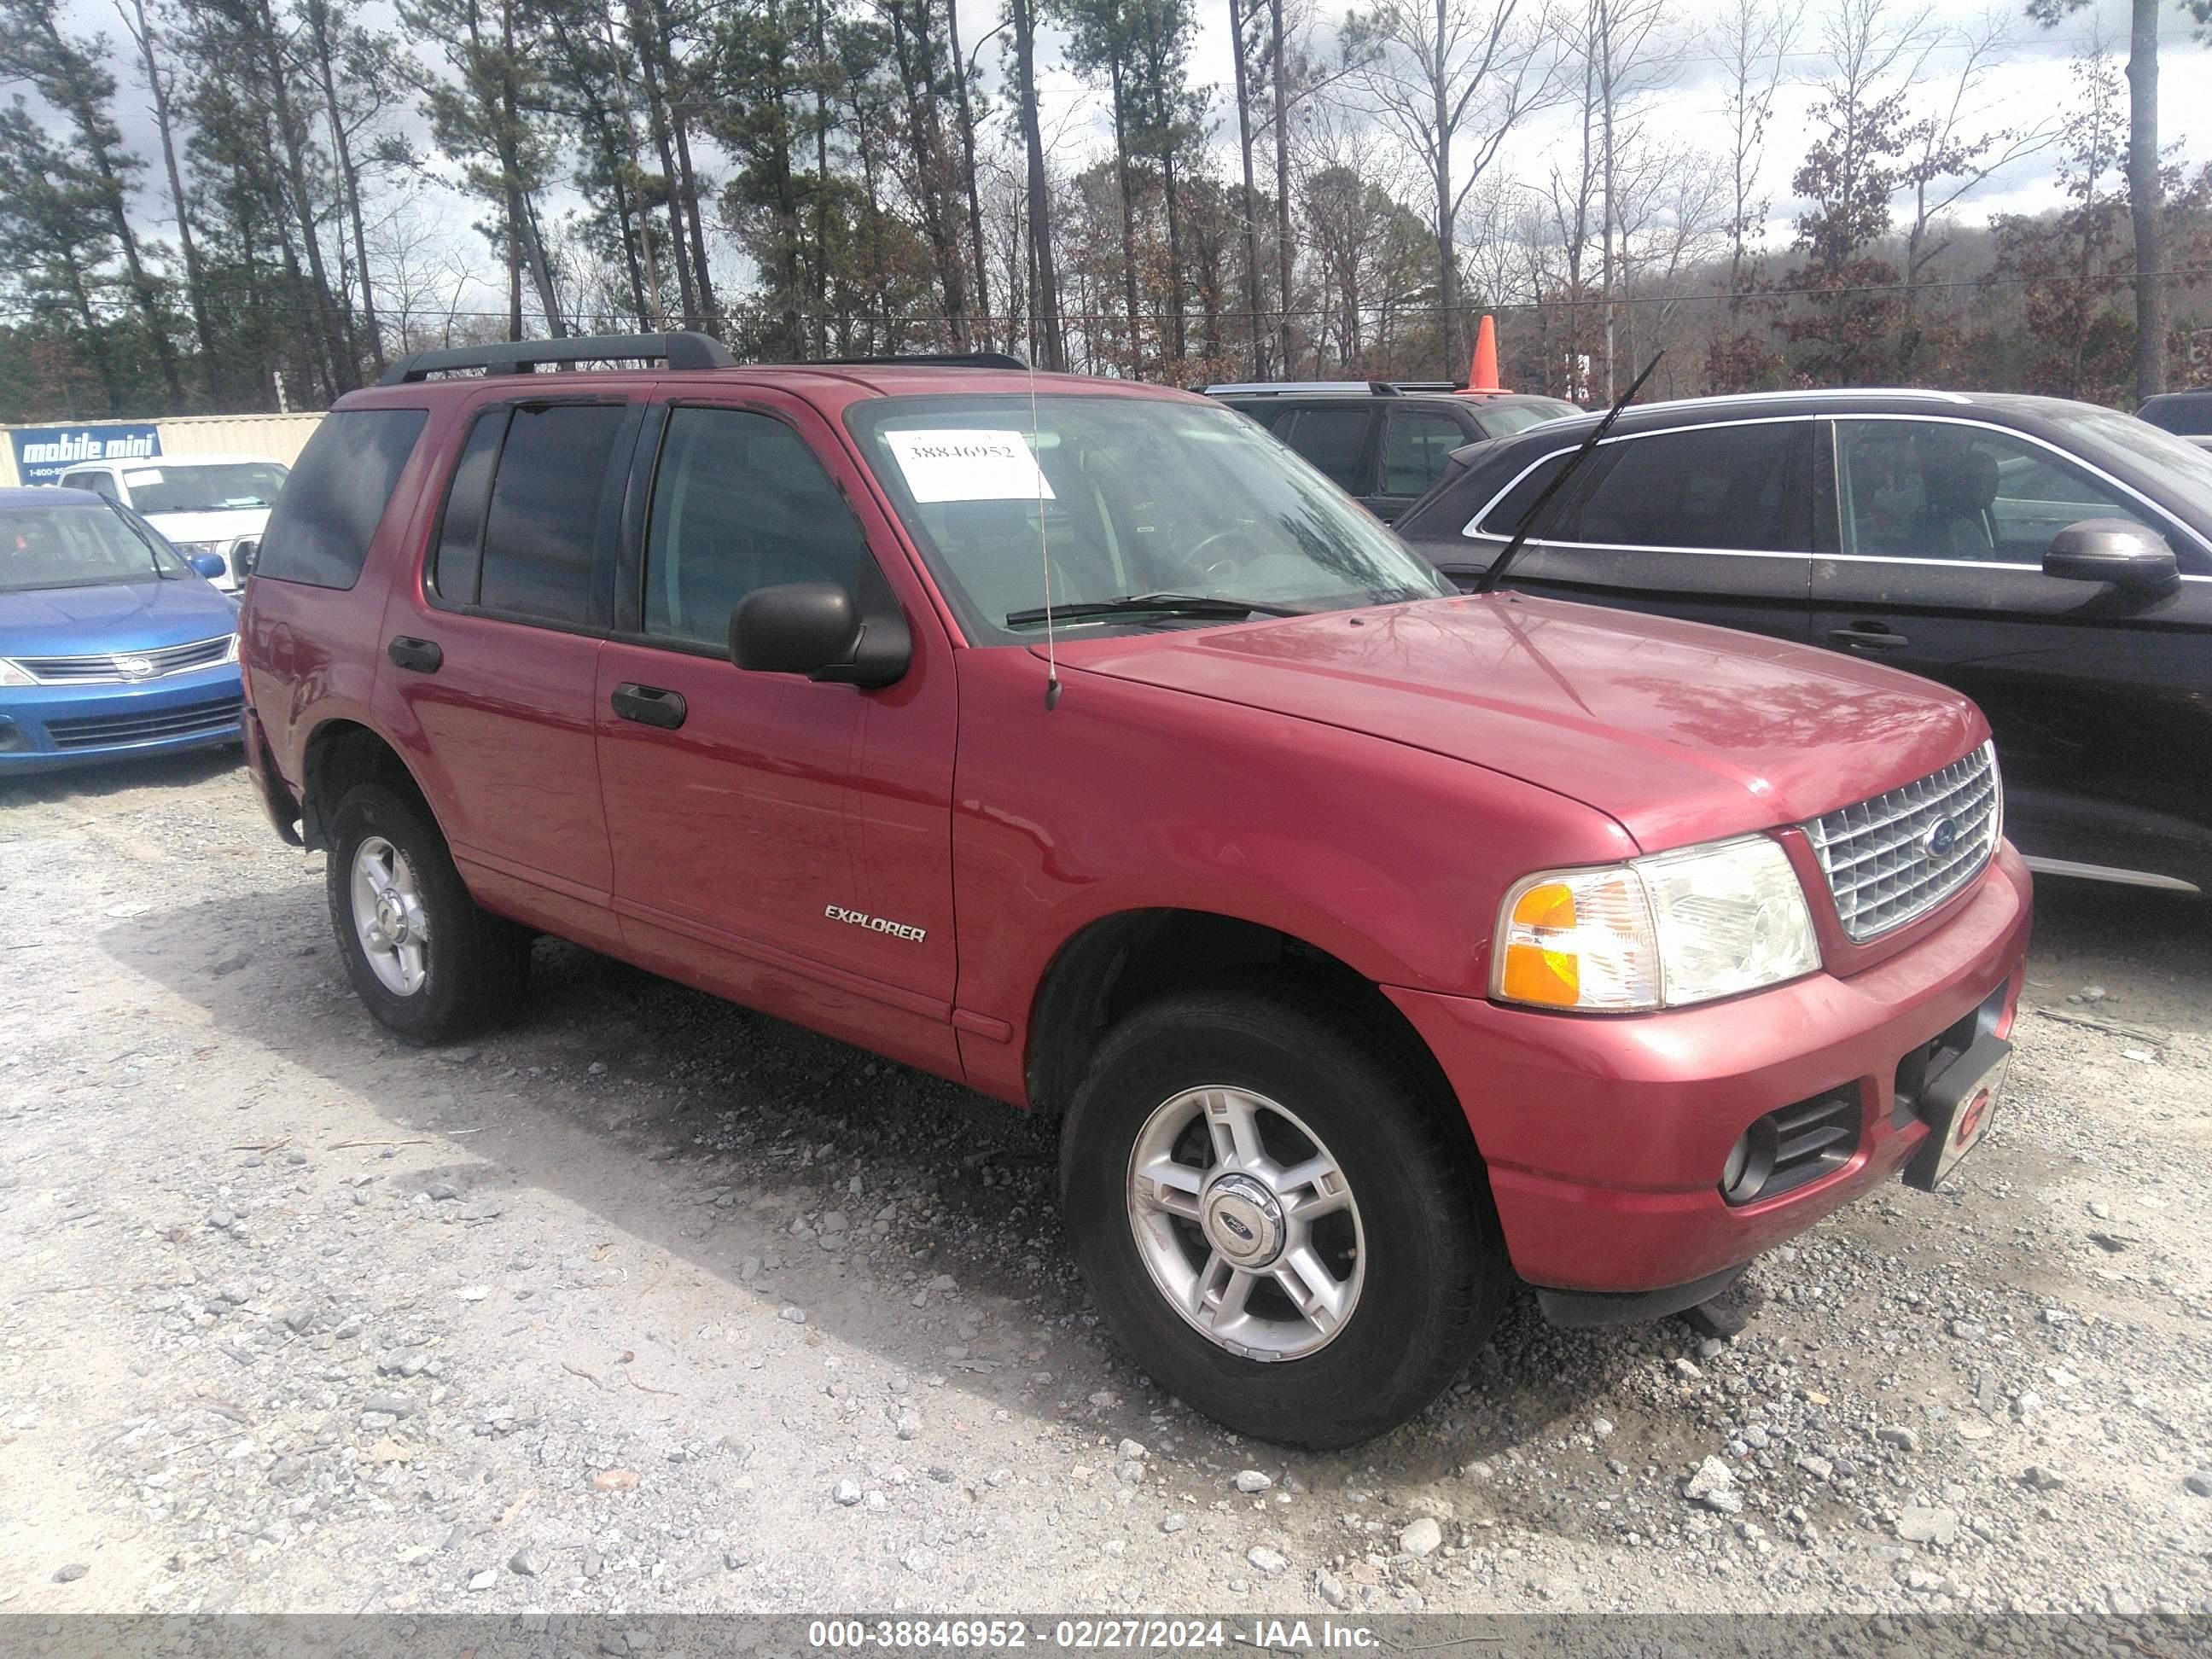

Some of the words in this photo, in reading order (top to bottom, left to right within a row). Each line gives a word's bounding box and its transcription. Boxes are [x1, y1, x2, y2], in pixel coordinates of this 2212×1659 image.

[23, 433, 102, 463] mobile
[105, 434, 154, 457] mini
[910, 445, 1016, 460] 38846952
[824, 904, 926, 943] EXPLORER
